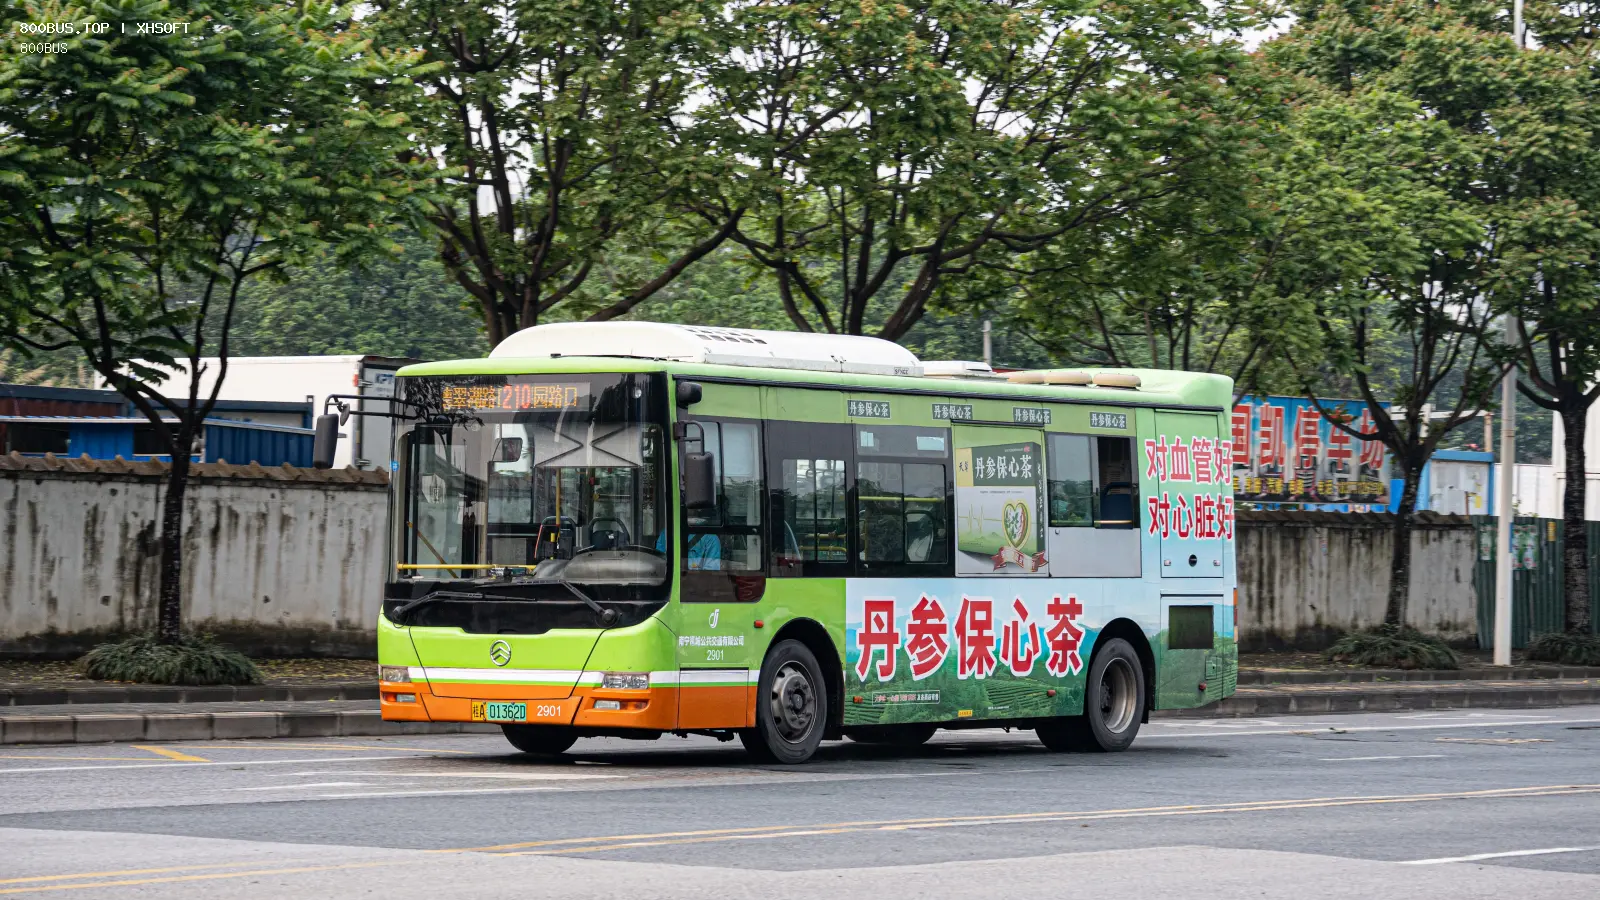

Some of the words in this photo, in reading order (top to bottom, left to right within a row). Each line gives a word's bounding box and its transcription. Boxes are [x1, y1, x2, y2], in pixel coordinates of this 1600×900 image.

[502, 384, 531, 409] 210
[849, 402, 889, 418] 丹参保心茶
[933, 404, 972, 420] 丹参保心茶
[1014, 408, 1051, 423] 丹参保心茶
[1090, 412, 1127, 429] 丹参保心茶
[975, 454, 1032, 479] 丹参保心茶
[1144, 435, 1233, 484] 对血管好
[1147, 492, 1235, 540] 对心脏好
[856, 593, 1085, 681] 丹参保心茶
[706, 649, 724, 661] 2901
[489, 704, 526, 720] 01362D
[536, 705, 561, 717] 2901
